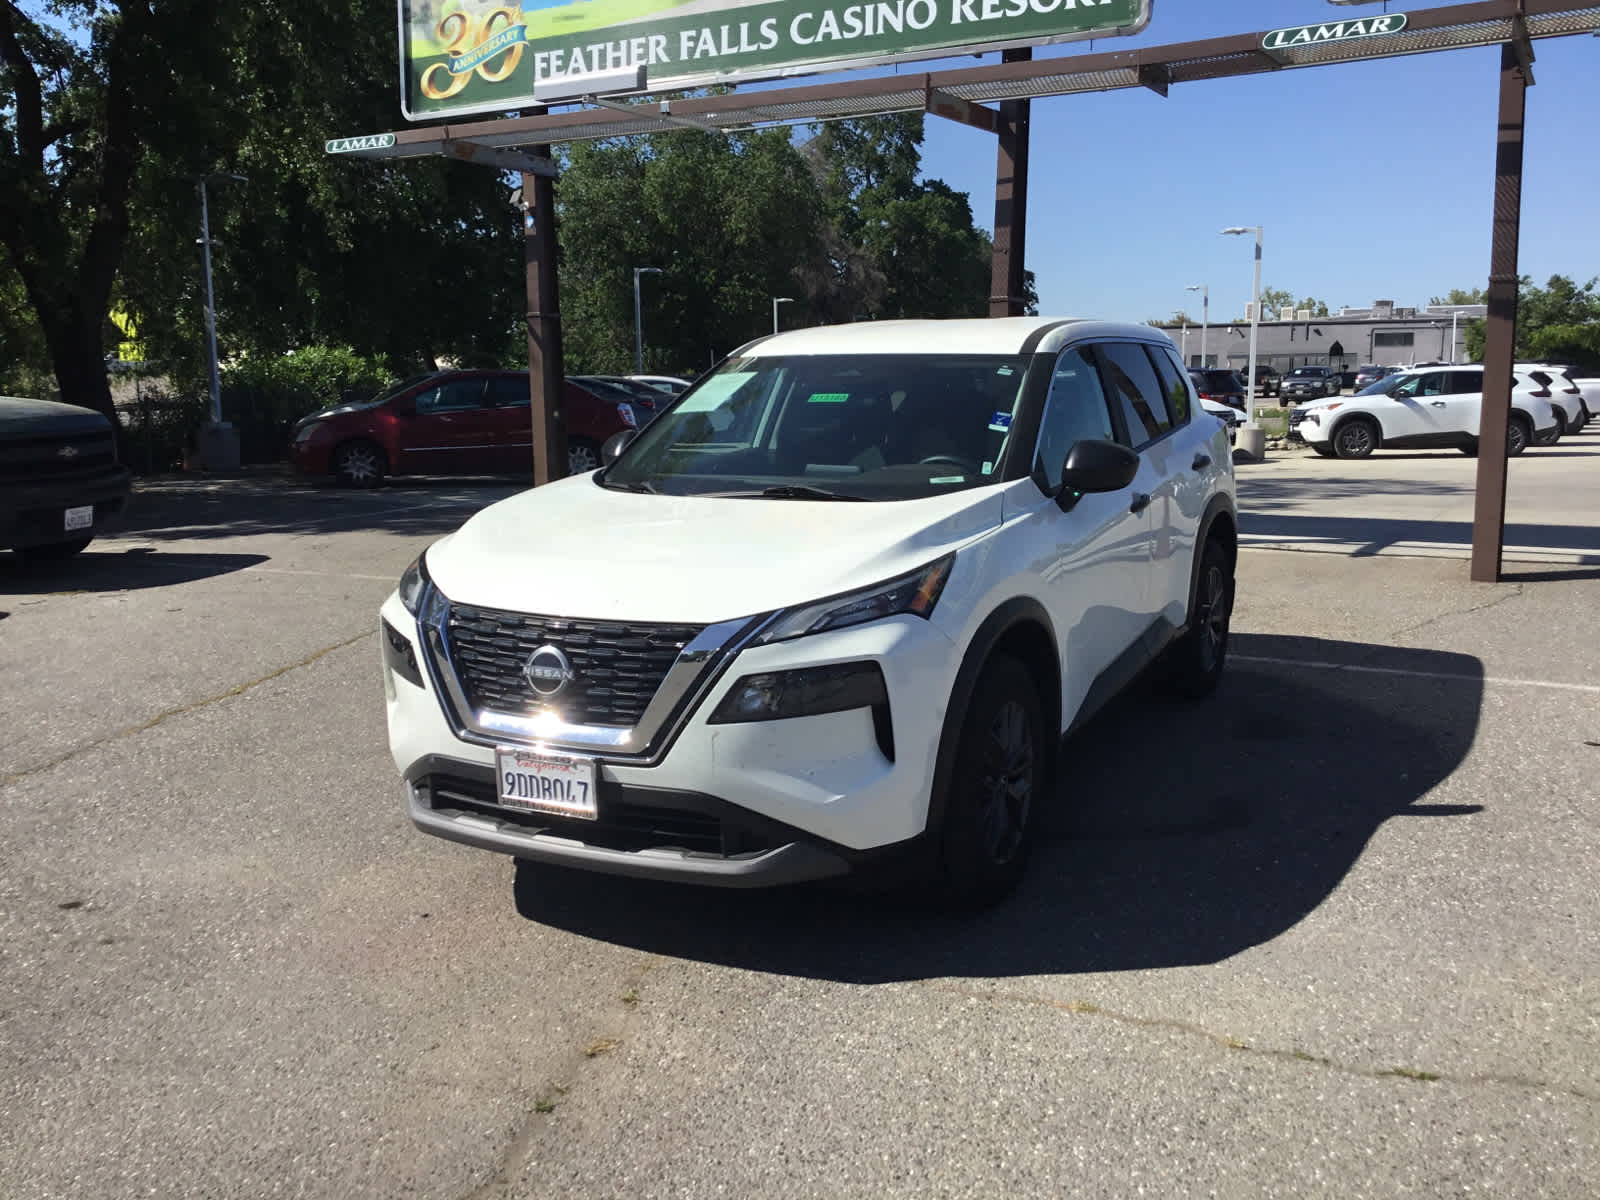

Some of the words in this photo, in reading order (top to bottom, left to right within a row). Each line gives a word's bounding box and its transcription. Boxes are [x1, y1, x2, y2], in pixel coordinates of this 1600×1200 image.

[453, 28, 519, 73] ANNIVERSARY
[534, 34, 671, 80] FEATHER
[679, 18, 780, 60] FALLS
[790, 0, 938, 45] CASINO
[950, 0, 1113, 24] RES
[1274, 17, 1391, 47] LAMAR
[421, 8, 523, 99] 30
[332, 135, 389, 151] LAMAR
[523, 665, 576, 680] NISSAN
